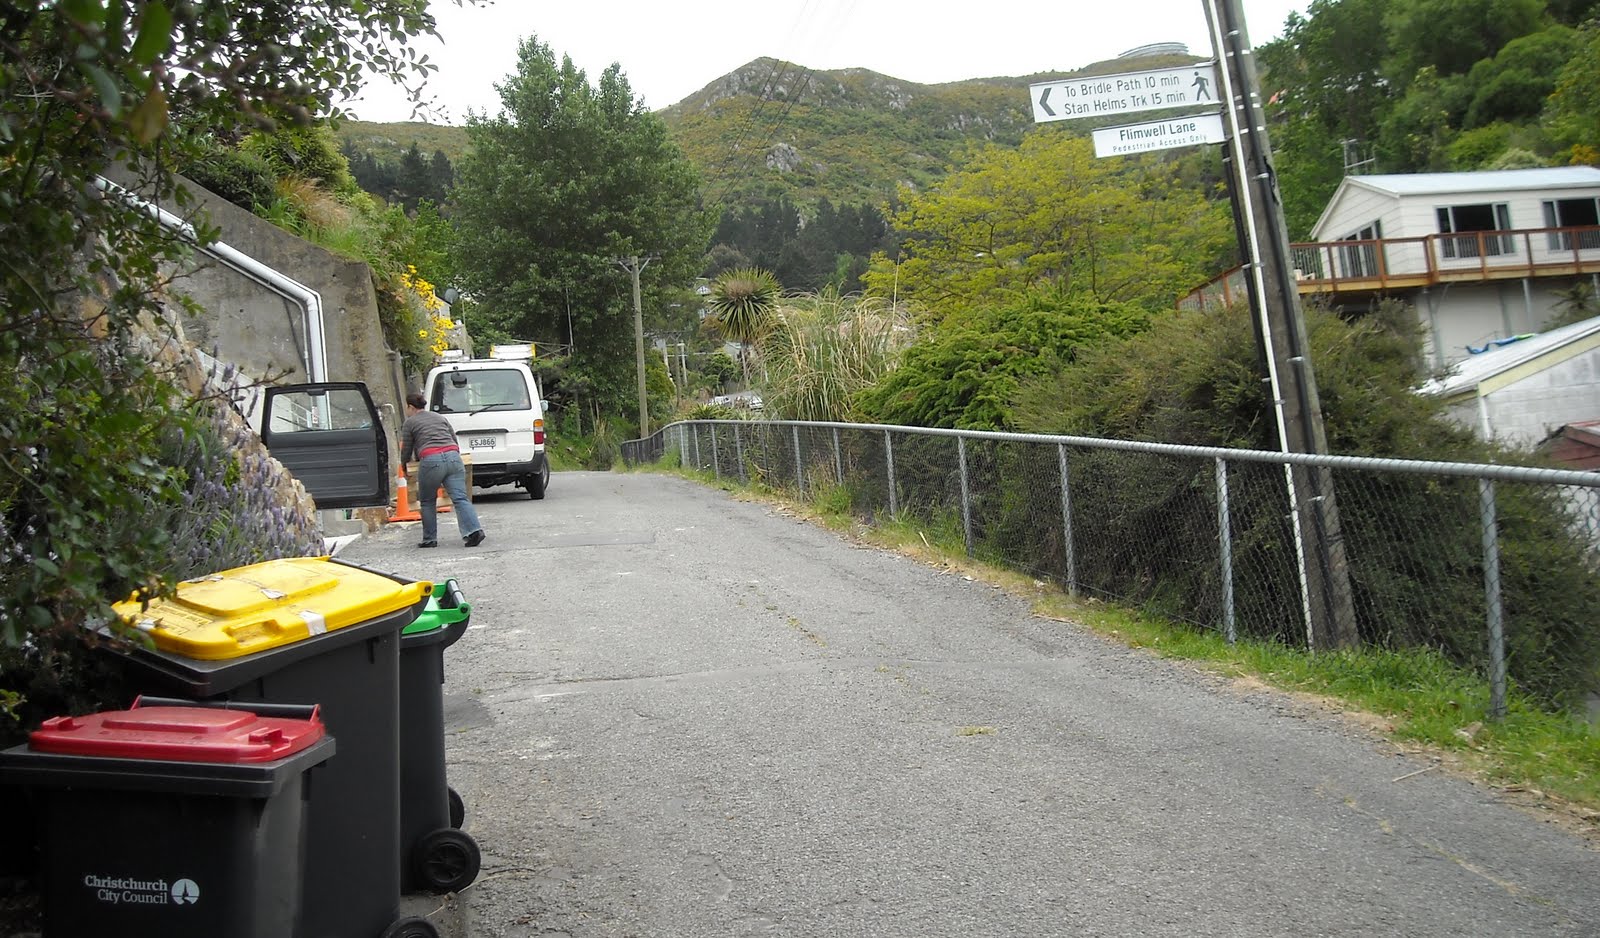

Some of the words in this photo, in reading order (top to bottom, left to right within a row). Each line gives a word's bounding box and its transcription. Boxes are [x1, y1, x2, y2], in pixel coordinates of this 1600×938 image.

[1064, 86, 1076, 98] To
[1081, 82, 1111, 95] Bridle
[1116, 77, 1141, 91] Path
[1145, 76, 1156, 88] 10
[1160, 75, 1180, 87] min
[1064, 101, 1090, 115] Stan
[1094, 98, 1127, 112] Helms
[1131, 95, 1147, 107] Trk
[1151, 93, 1162, 104] 15
[1166, 91, 1186, 103] min
[1119, 127, 1166, 141] Flimwell
[1169, 122, 1196, 135] Lane
[1112, 141, 1155, 153] Pedestrian
[1159, 138, 1186, 147] Access
[1189, 134, 1208, 144] Only
[470, 438, 495, 446] ESJ866
[85, 875, 168, 891] Christchurch
[97, 889, 121, 904] City
[122, 891, 168, 904] Council
